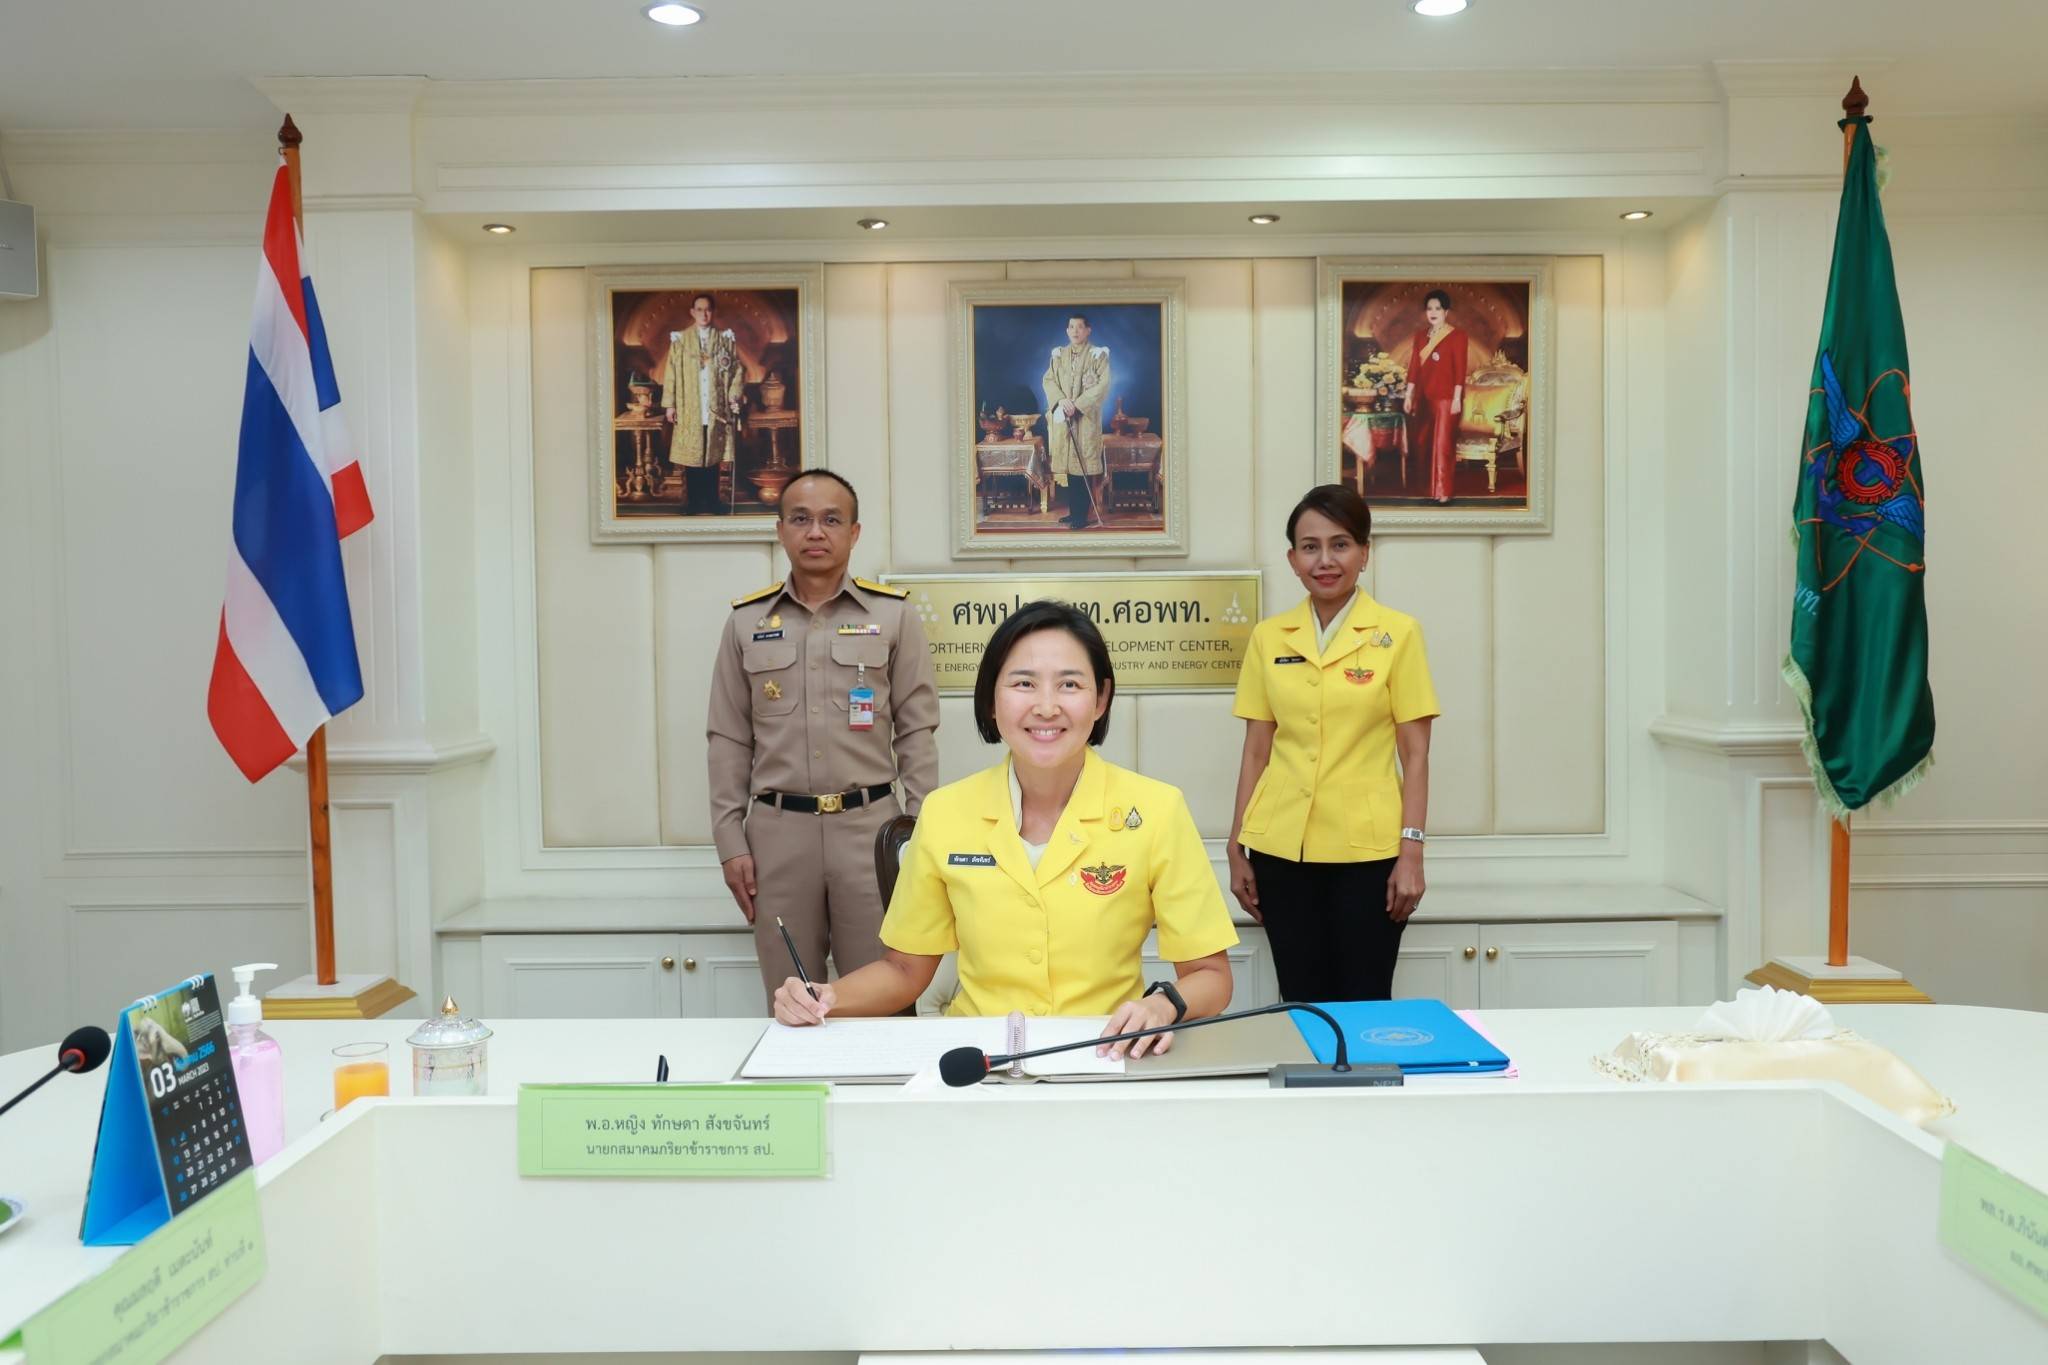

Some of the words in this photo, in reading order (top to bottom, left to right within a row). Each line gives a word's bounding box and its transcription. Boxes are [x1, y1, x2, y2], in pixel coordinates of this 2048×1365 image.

[928, 642, 987, 655] ORTHERN
[1104, 639, 1176, 653] ELOPMENT
[1179, 639, 1233, 653] CENTER,
[944, 663, 980, 672] ENERGY
[1148, 660, 1169, 670] AND
[1171, 660, 1209, 670] ENERGY
[1211, 659, 1242, 670] CENTE
[150, 1062, 177, 1098] 03
[178, 1068, 198, 1086] MARCH
[586, 1114, 646, 1135] พ.อ.หญิง
[651, 1114, 700, 1131] ทักษดา
[705, 1113, 770, 1131] สังขจันทร์
[753, 1142, 775, 1156] สป.
